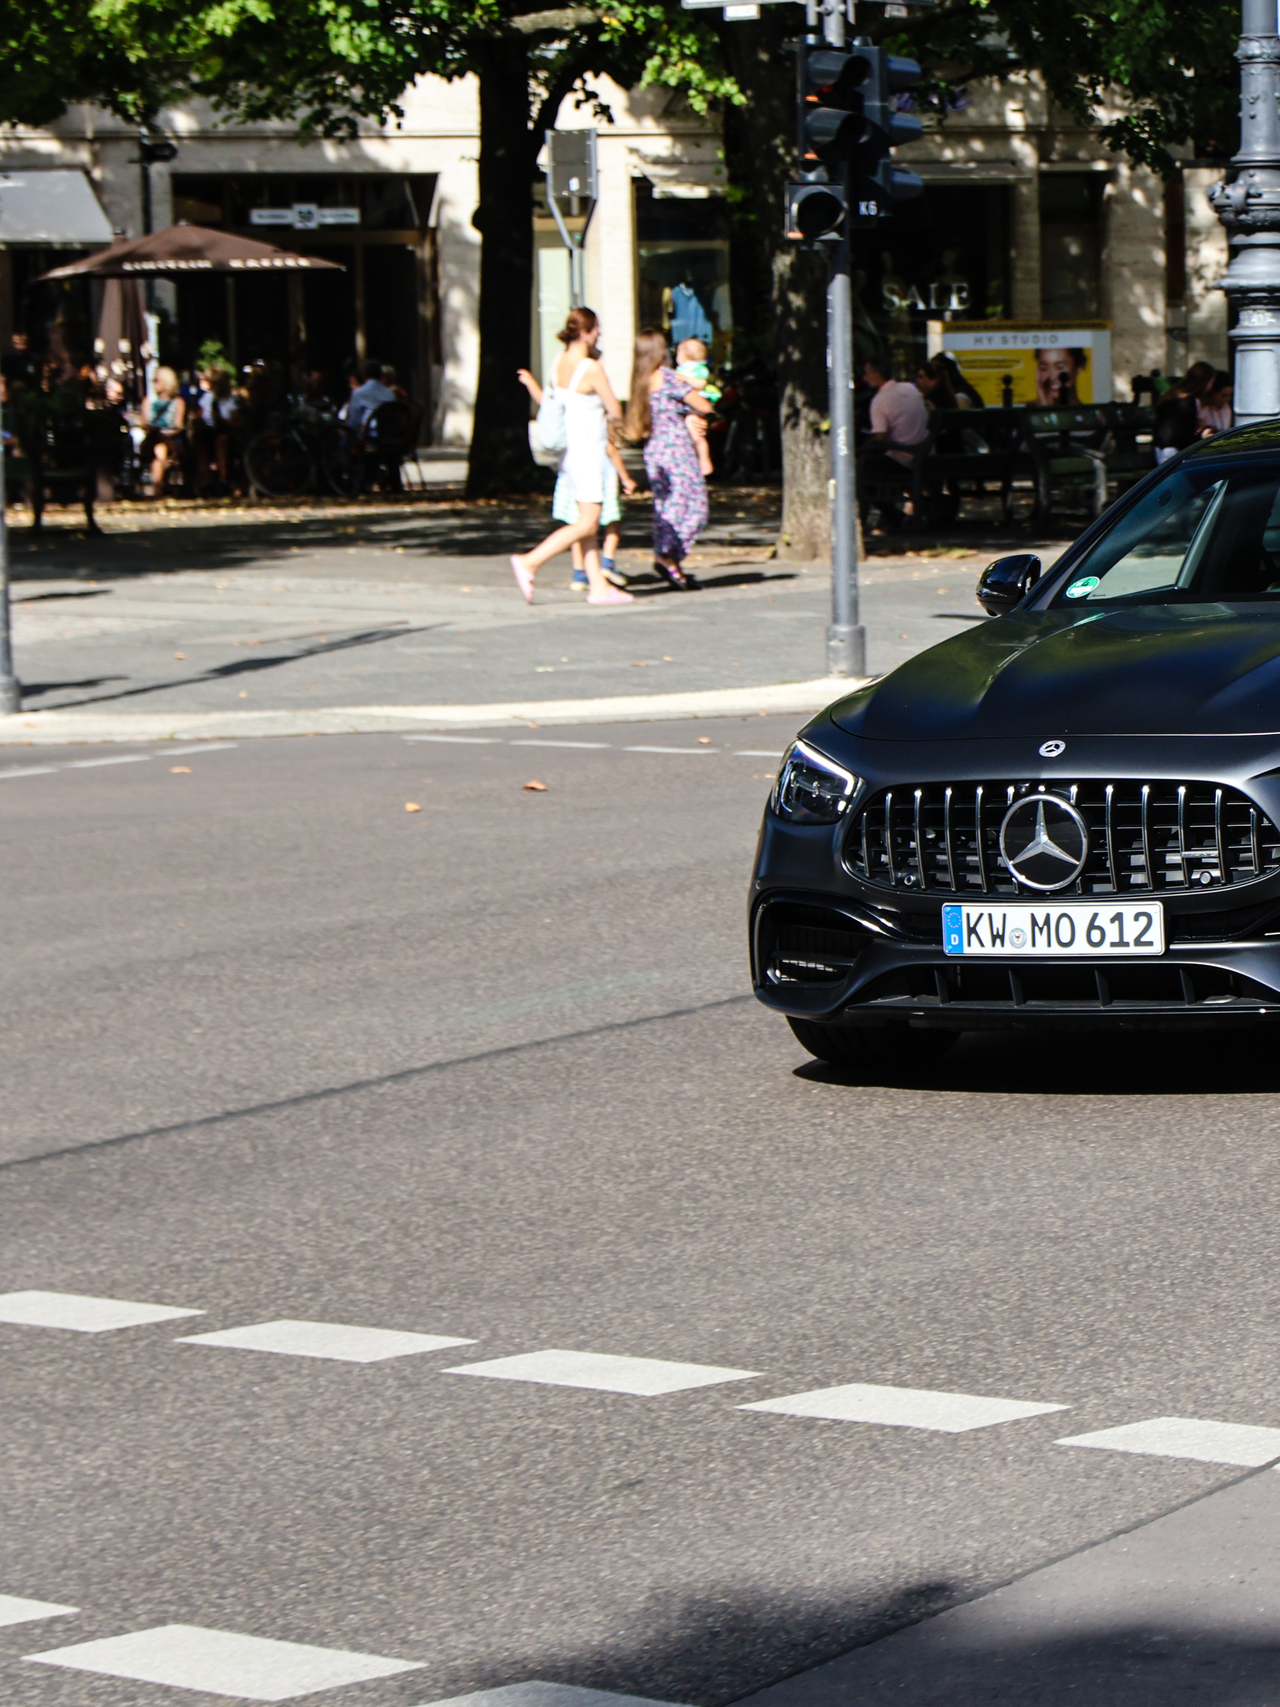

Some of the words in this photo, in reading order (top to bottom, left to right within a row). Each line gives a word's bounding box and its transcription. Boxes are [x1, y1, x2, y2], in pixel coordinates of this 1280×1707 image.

[858, 201, 878, 216] K6
[883, 282, 970, 311] SALE
[1001, 334, 1060, 346] STUDIO
[965, 912, 1007, 949] KW
[1030, 912, 1076, 949] MO
[1085, 911, 1154, 948] 612
[950, 934, 960, 945] D
